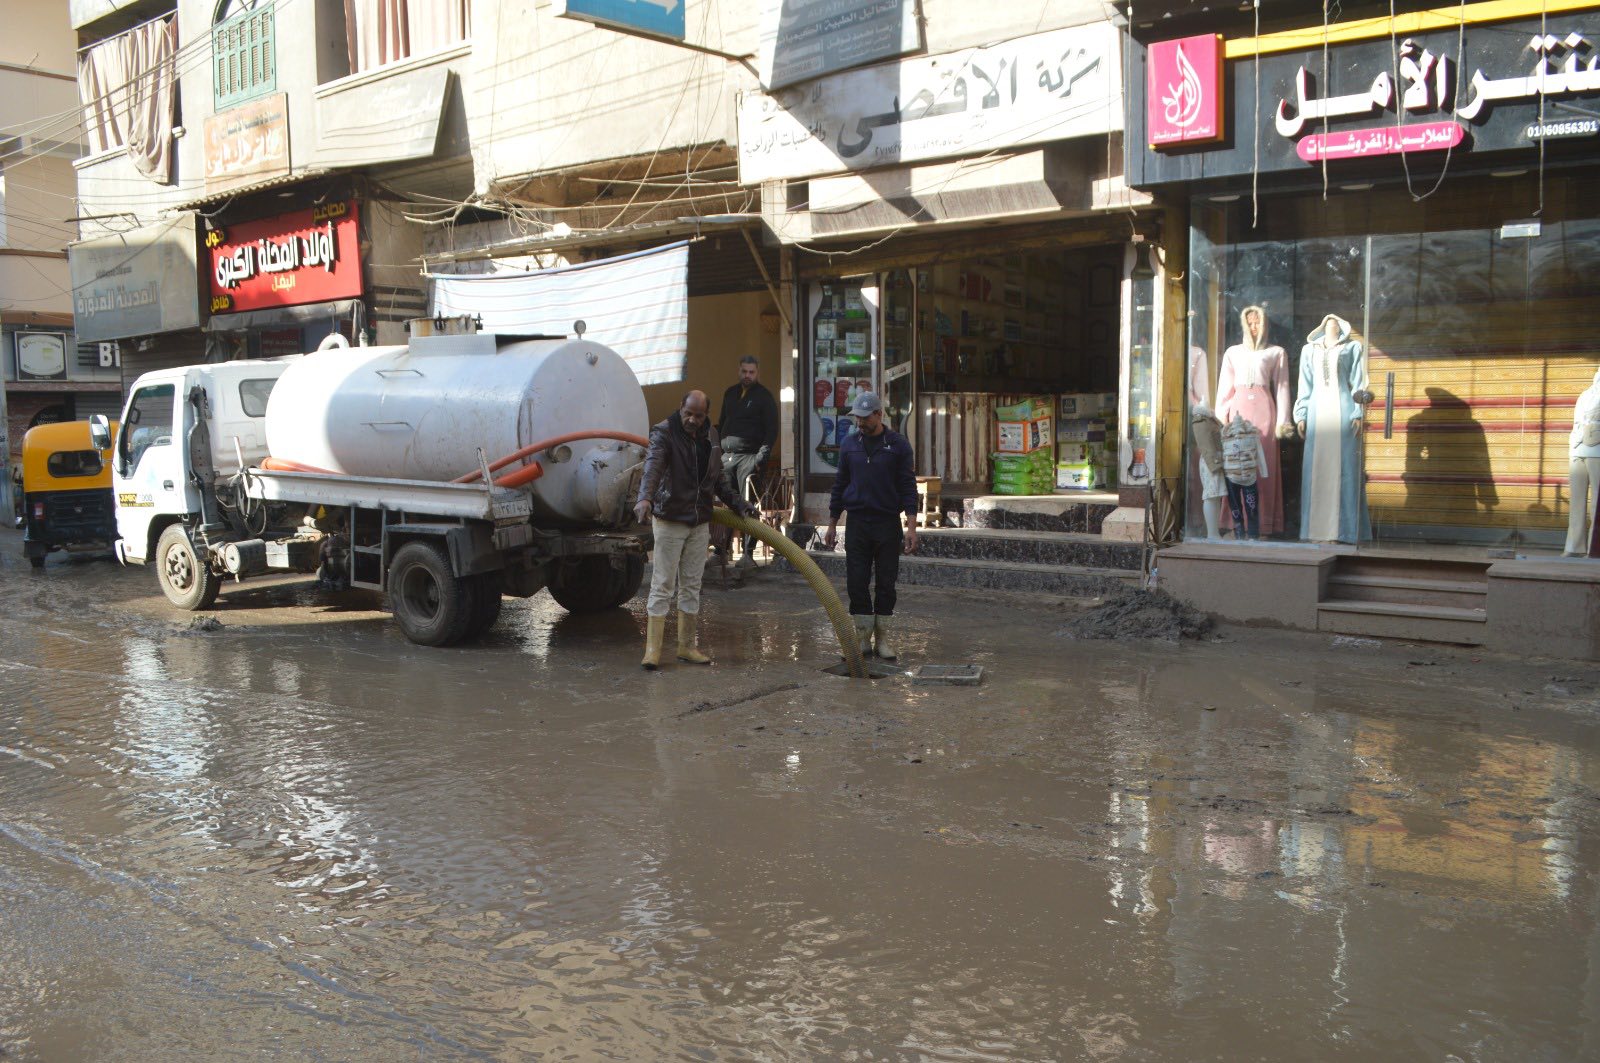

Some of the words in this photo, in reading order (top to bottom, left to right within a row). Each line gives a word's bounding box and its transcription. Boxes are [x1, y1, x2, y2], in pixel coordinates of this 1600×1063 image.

[1036, 48, 1101, 98] شركة
[313, 201, 345, 221] مطاعم
[205, 230, 224, 248] فول
[258, 235, 299, 272] المحلة
[302, 221, 334, 272] أولاد
[215, 245, 253, 288] الكبرى
[77, 288, 115, 318] المنورة
